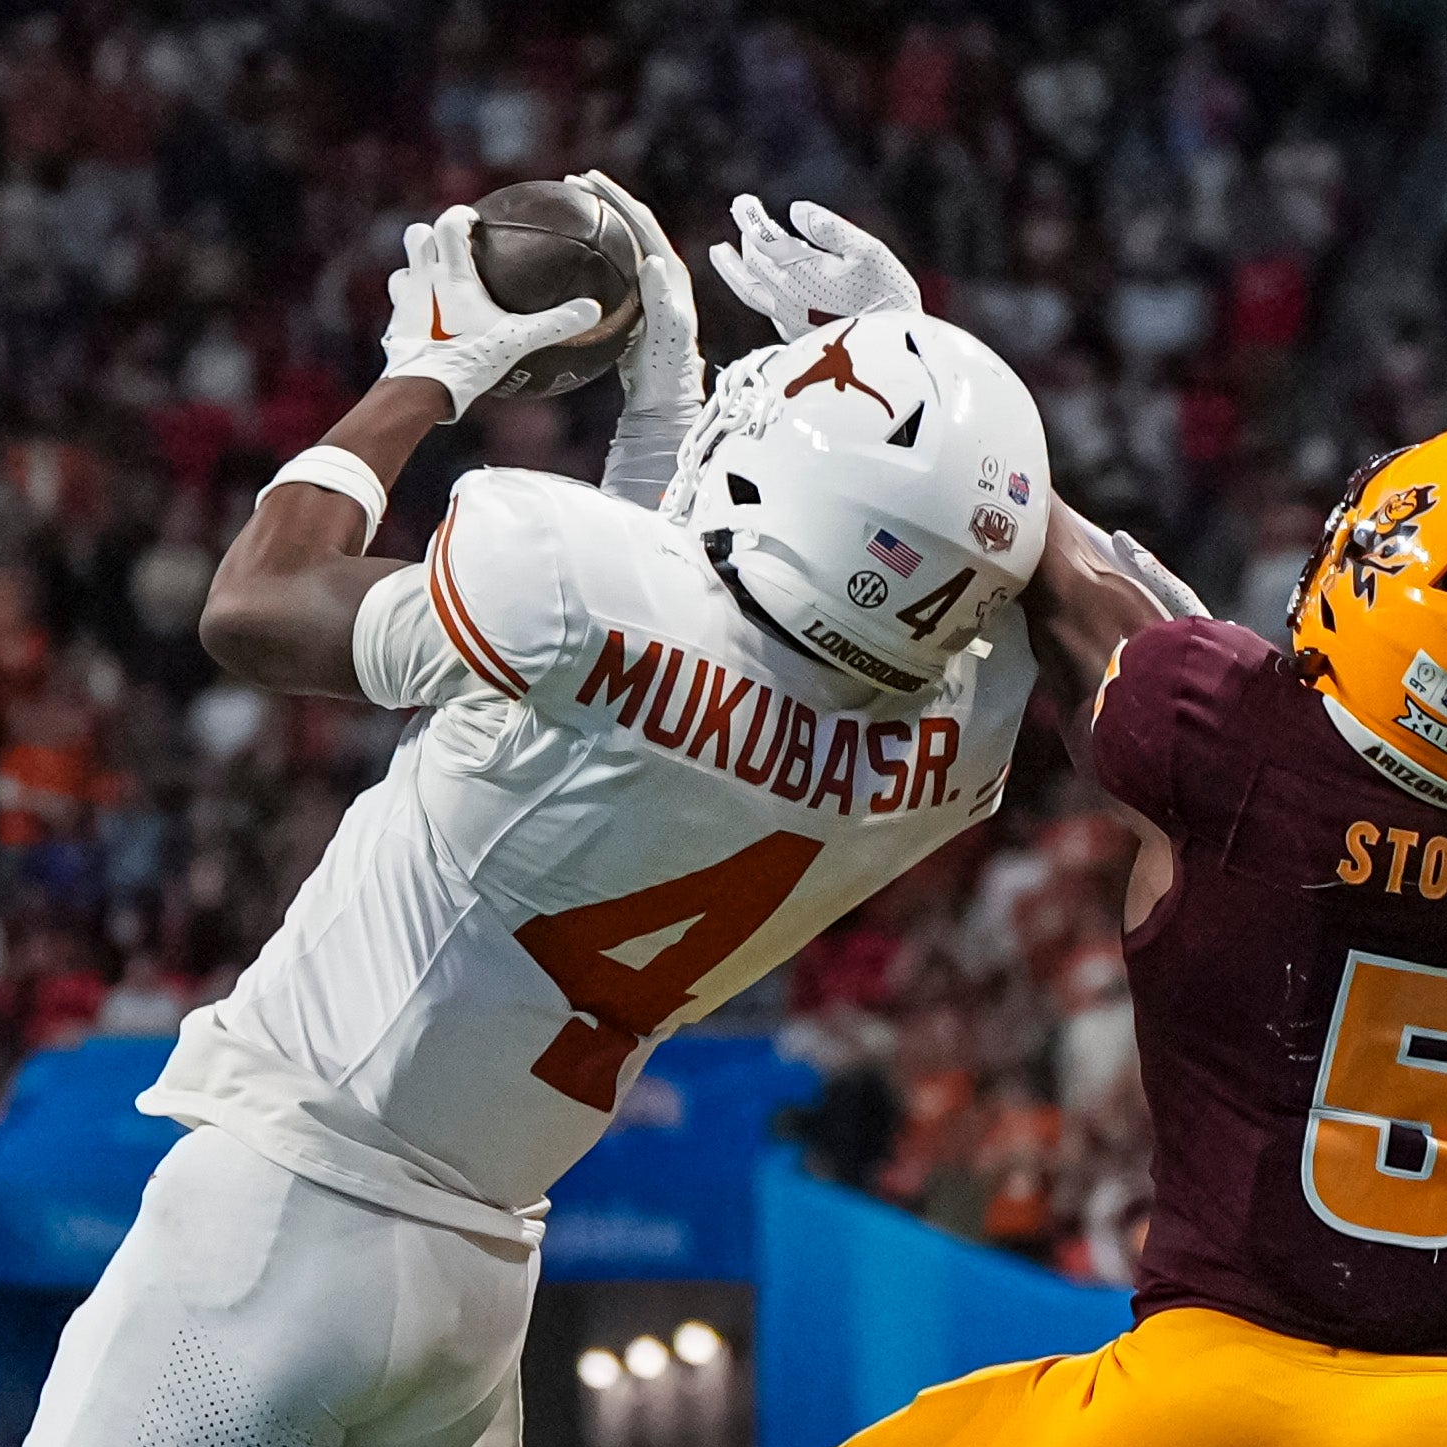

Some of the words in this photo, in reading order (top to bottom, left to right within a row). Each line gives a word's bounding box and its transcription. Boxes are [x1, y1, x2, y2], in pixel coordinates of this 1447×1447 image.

[895, 566, 978, 641] 4
[575, 630, 859, 815] MUKUBA
[865, 717, 961, 814] SR.
[513, 830, 825, 1113] 4
